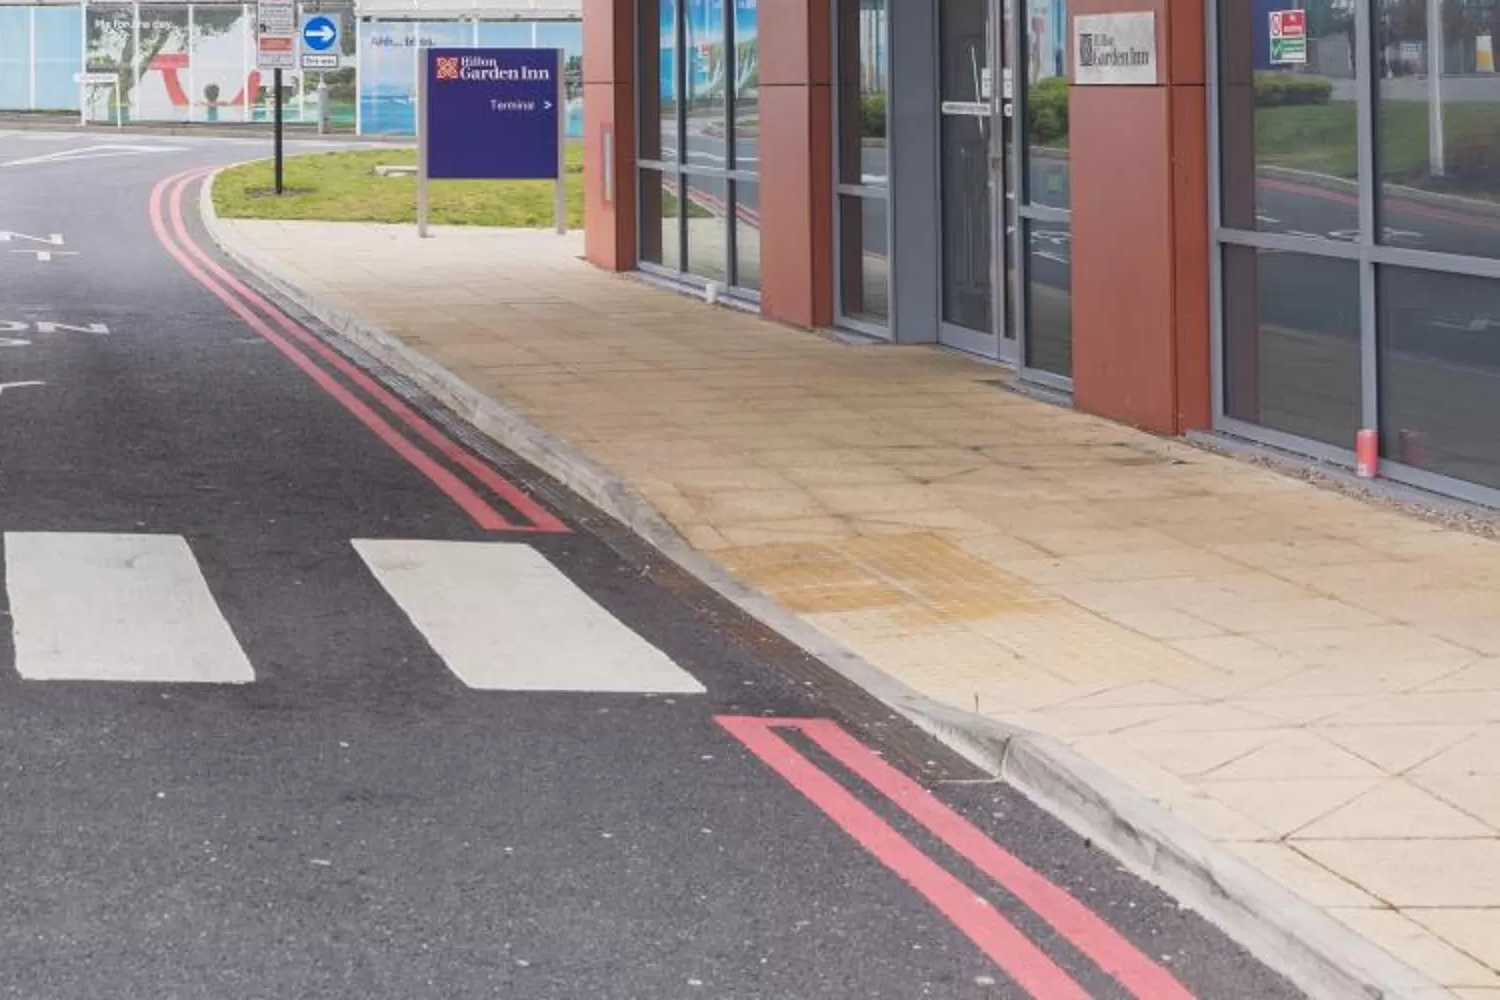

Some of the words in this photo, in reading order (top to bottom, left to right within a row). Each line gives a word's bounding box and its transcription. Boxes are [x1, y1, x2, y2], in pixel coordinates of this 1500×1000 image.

[461, 56, 498, 67] Hilton
[460, 66, 519, 80] Garden
[521, 66, 550, 80] Inn
[490, 99, 536, 112] Terminal
